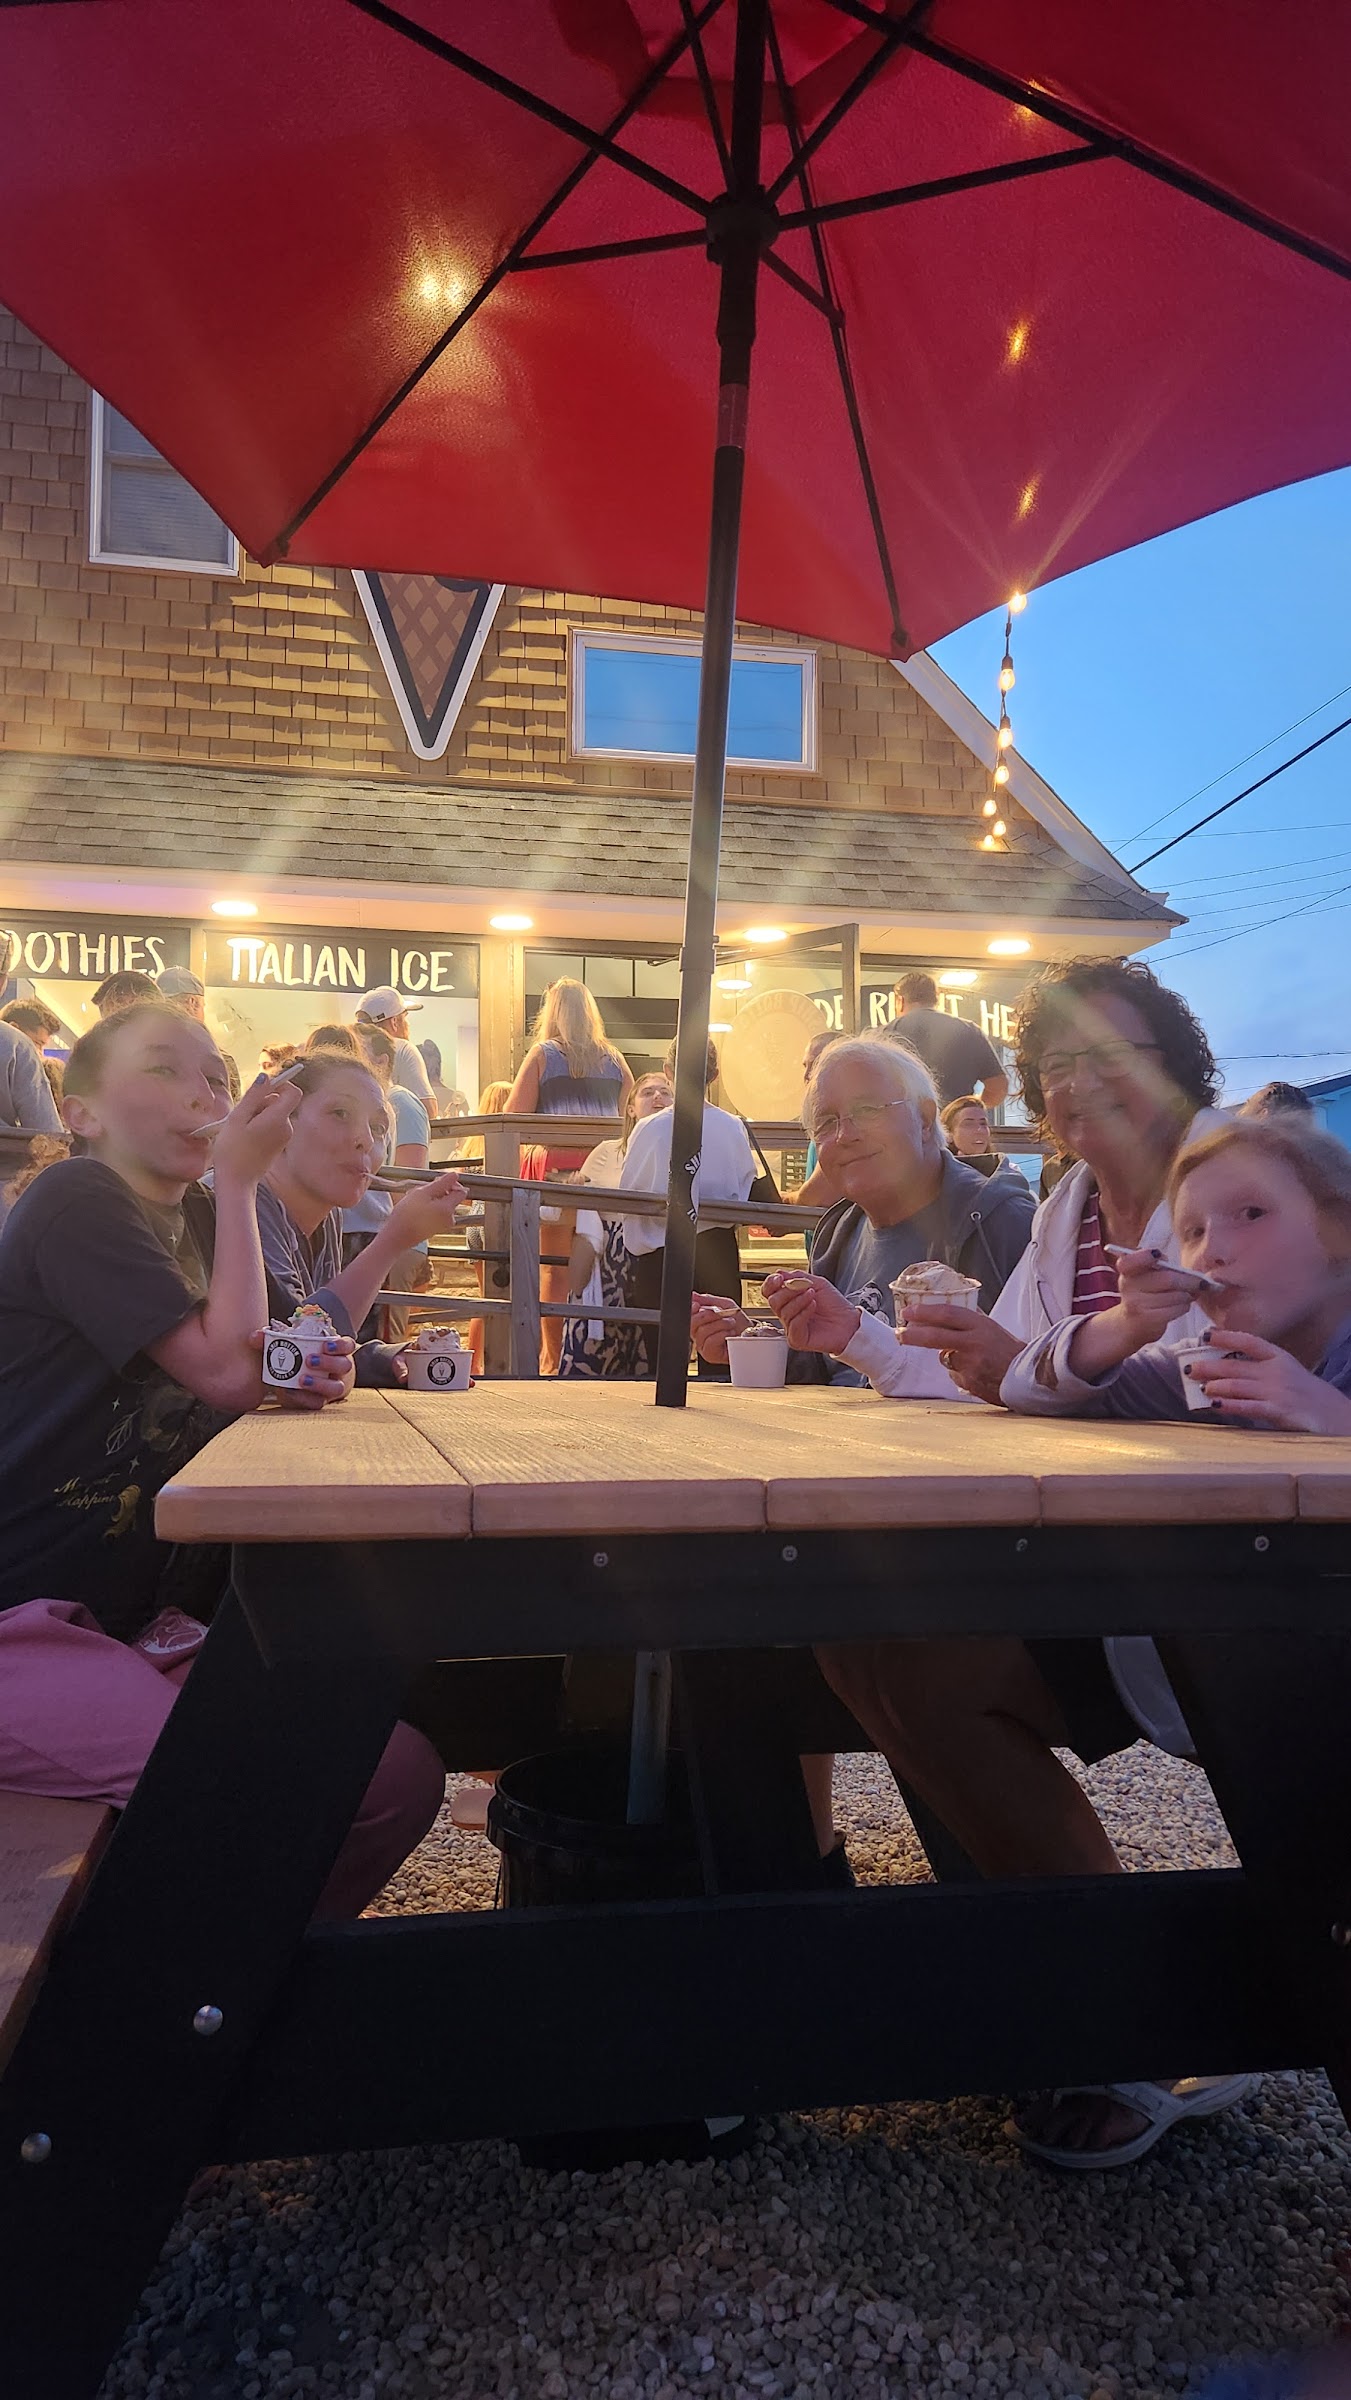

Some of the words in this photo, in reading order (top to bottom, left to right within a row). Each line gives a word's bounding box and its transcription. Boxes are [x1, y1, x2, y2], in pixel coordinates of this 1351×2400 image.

[231, 939, 366, 988] ITALIAN
[391, 948, 455, 992] ICE
[869, 991, 964, 1028] RIT
